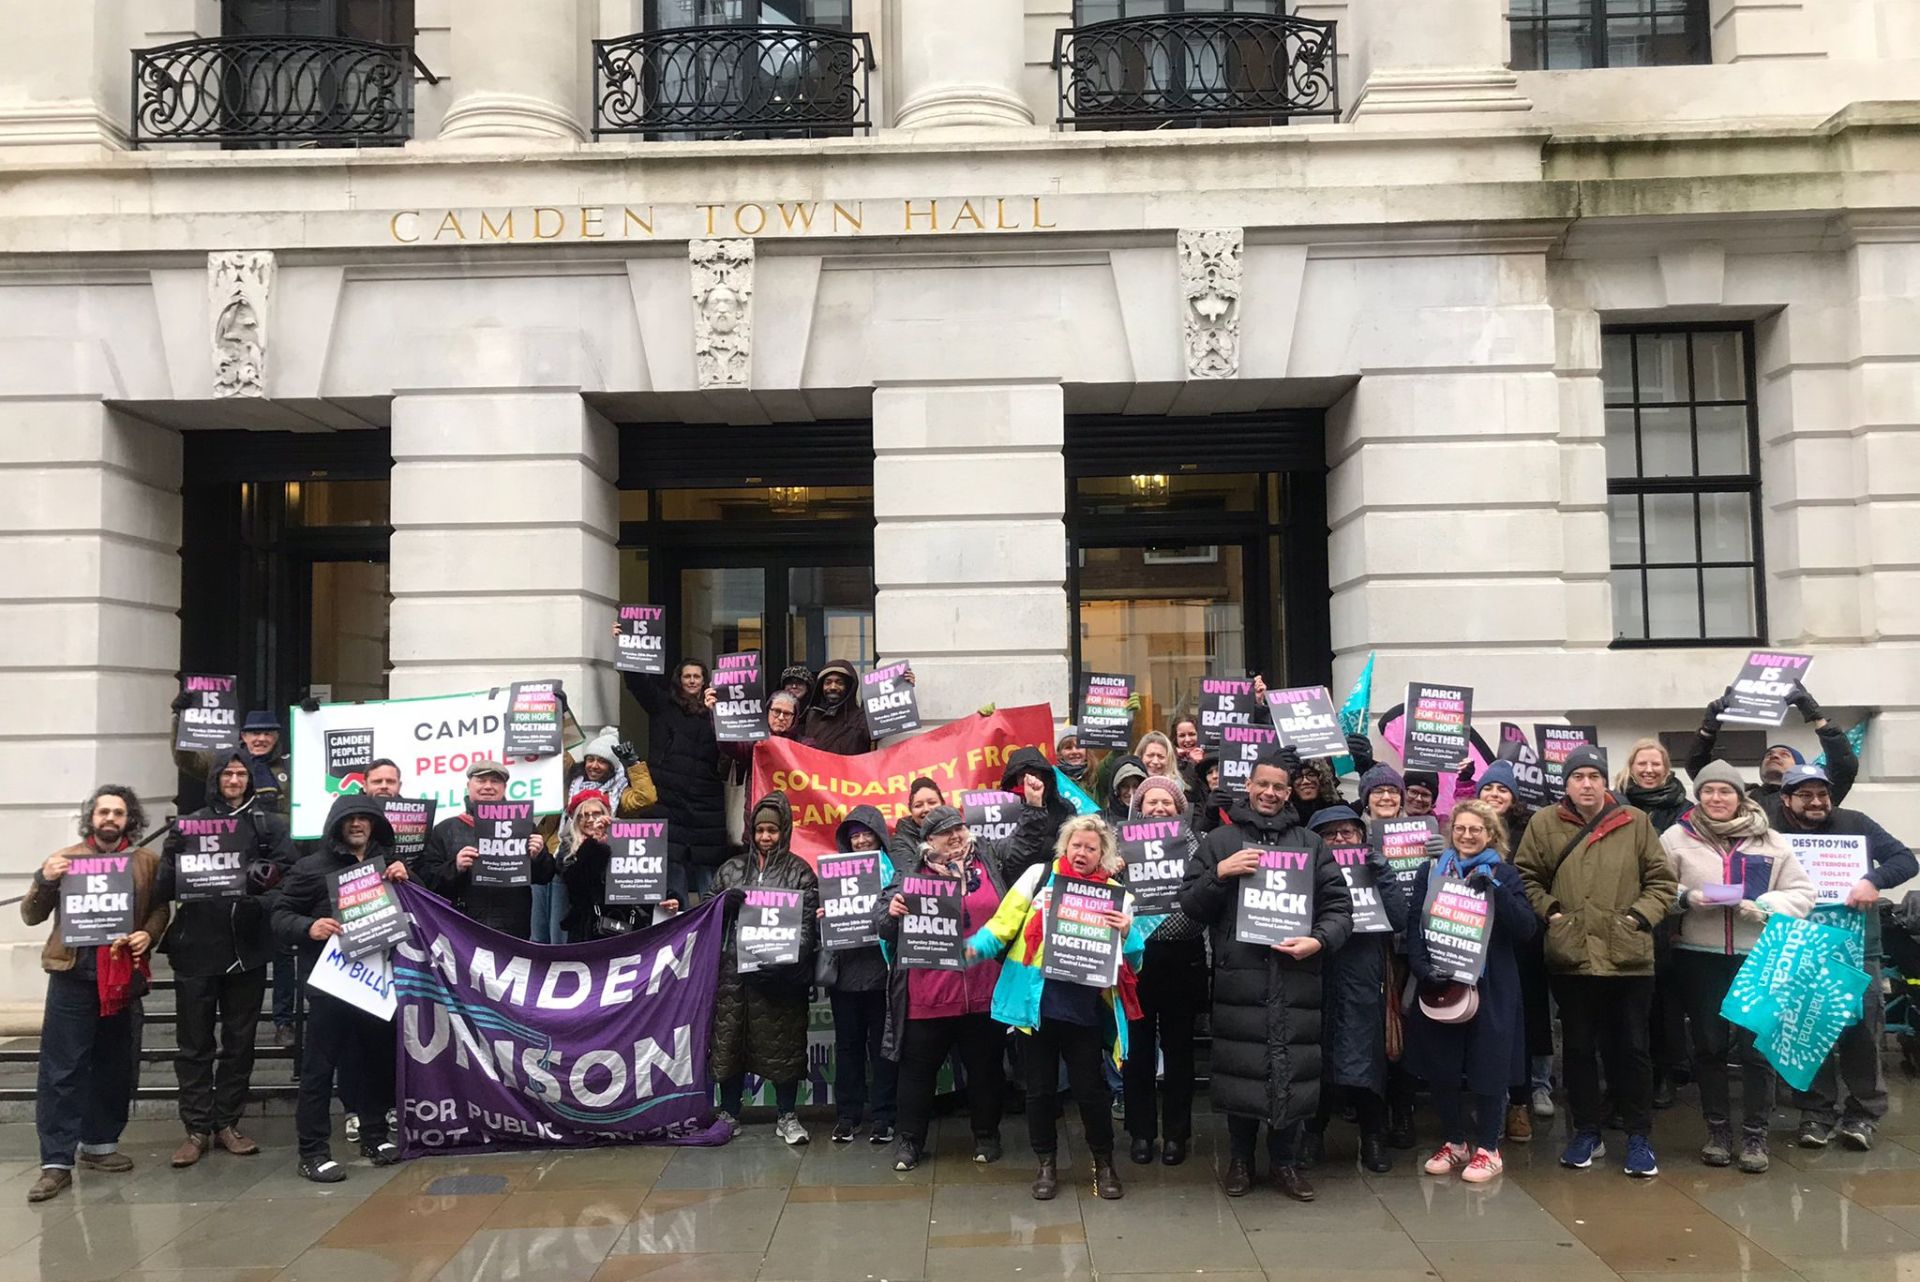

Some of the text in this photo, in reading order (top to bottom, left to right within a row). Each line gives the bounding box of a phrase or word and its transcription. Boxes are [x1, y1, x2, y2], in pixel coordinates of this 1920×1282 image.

[391, 198, 1056, 243] CAMDEN TOWN HALL
[620, 606, 662, 620] UNITY
[633, 620, 648, 635] IS
[618, 634, 662, 650] BACK
[718, 654, 757, 669] UNITY
[1750, 653, 1808, 669] UNITY
[713, 670, 758, 685] UNITY
[863, 663, 906, 685] UNITY
[1091, 677, 1125, 687] MARCH
[1760, 667, 1783, 681] IS
[187, 676, 232, 692] UNITY
[520, 684, 553, 693] MARCH
[879, 679, 895, 695] IS
[1091, 688, 1105, 696] FOR
[1203, 680, 1252, 695] UNITY
[1735, 679, 1793, 697] BACK
[202, 691, 219, 708] IS
[728, 685, 745, 700] IS
[1269, 687, 1321, 705] UNITY
[1420, 688, 1462, 700] MARCH
[715, 700, 762, 716] BACK
[867, 690, 913, 713] BACK
[1089, 697, 1103, 705] FOR
[1218, 695, 1235, 711] IS
[1291, 701, 1312, 717] IS
[1420, 701, 1436, 710] FOR
[184, 708, 235, 725] BACK
[1088, 706, 1104, 715] FOR
[1417, 710, 1434, 719] FOR
[510, 722, 557, 732] TOGETHER
[1083, 716, 1129, 726] TOGETHER
[1202, 711, 1250, 727] BACK
[1279, 713, 1335, 732] BACK
[1417, 722, 1435, 731] FOR
[414, 715, 506, 741] CAMD
[1224, 727, 1276, 744] UNITY
[1546, 729, 1584, 740] MARCH
[331, 734, 371, 747] CAMDEN
[1411, 731, 1464, 746] TOGETHER
[331, 745, 371, 759] PEOPLE'S
[1241, 743, 1258, 760] IS
[332, 755, 371, 768] ALLIANCE
[1223, 760, 1254, 778] BA
[772, 758, 958, 797] SOLIDARITY
[385, 801, 425, 812] MARCH
[965, 791, 1015, 806] UNITY
[478, 804, 530, 819] UNITY
[984, 805, 1002, 823] IS
[495, 820, 513, 838] IS
[611, 823, 664, 838] UNITY
[1122, 821, 1180, 842] UNITY
[1384, 821, 1427, 834] MARCH
[200, 835, 220, 852] IS
[479, 838, 527, 856] BACK
[628, 838, 646, 856] IS
[1386, 835, 1403, 846] FOR
[1792, 838, 1859, 849] DESTROYING
[1144, 840, 1165, 861] IS
[1386, 847, 1401, 857] FOR
[181, 852, 241, 873] BACK
[610, 856, 663, 874] BACK
[821, 858, 875, 879] UNITY
[1259, 851, 1309, 870] NITY
[1389, 858, 1407, 870] FOR
[339, 863, 376, 885] MARCH
[1128, 858, 1185, 882] BACK
[87, 874, 108, 893] IS
[841, 877, 859, 896] IS
[903, 877, 957, 897] UNITY
[1265, 869, 1287, 891] IS
[744, 890, 800, 907] UNITY
[1066, 882, 1112, 900] MARCH
[1349, 887, 1377, 907] CK
[1817, 890, 1839, 899] LUES
[66, 893, 129, 914] BACK
[824, 894, 878, 918] BACK
[920, 896, 939, 915] IS
[1064, 896, 1083, 908] FOR
[1243, 887, 1307, 915] BACK
[1438, 897, 1456, 907] FOR
[760, 907, 780, 926] IS
[1060, 906, 1079, 919] FOR
[1433, 904, 1453, 916] FOR
[341, 905, 398, 933] TOGETHER
[903, 914, 958, 936] BACK
[1431, 918, 1450, 931] FOR
[741, 926, 797, 941] BACK
[1061, 922, 1080, 934] FOR
[1051, 933, 1112, 955] TOGETHER
[1424, 929, 1482, 954] TOGETHER
[327, 949, 349, 971] MY
[1758, 948, 1779, 987] union
[1797, 992, 1826, 1048] national
[403, 1002, 694, 1108] UNISON
[404, 1098, 457, 1121] FOR
